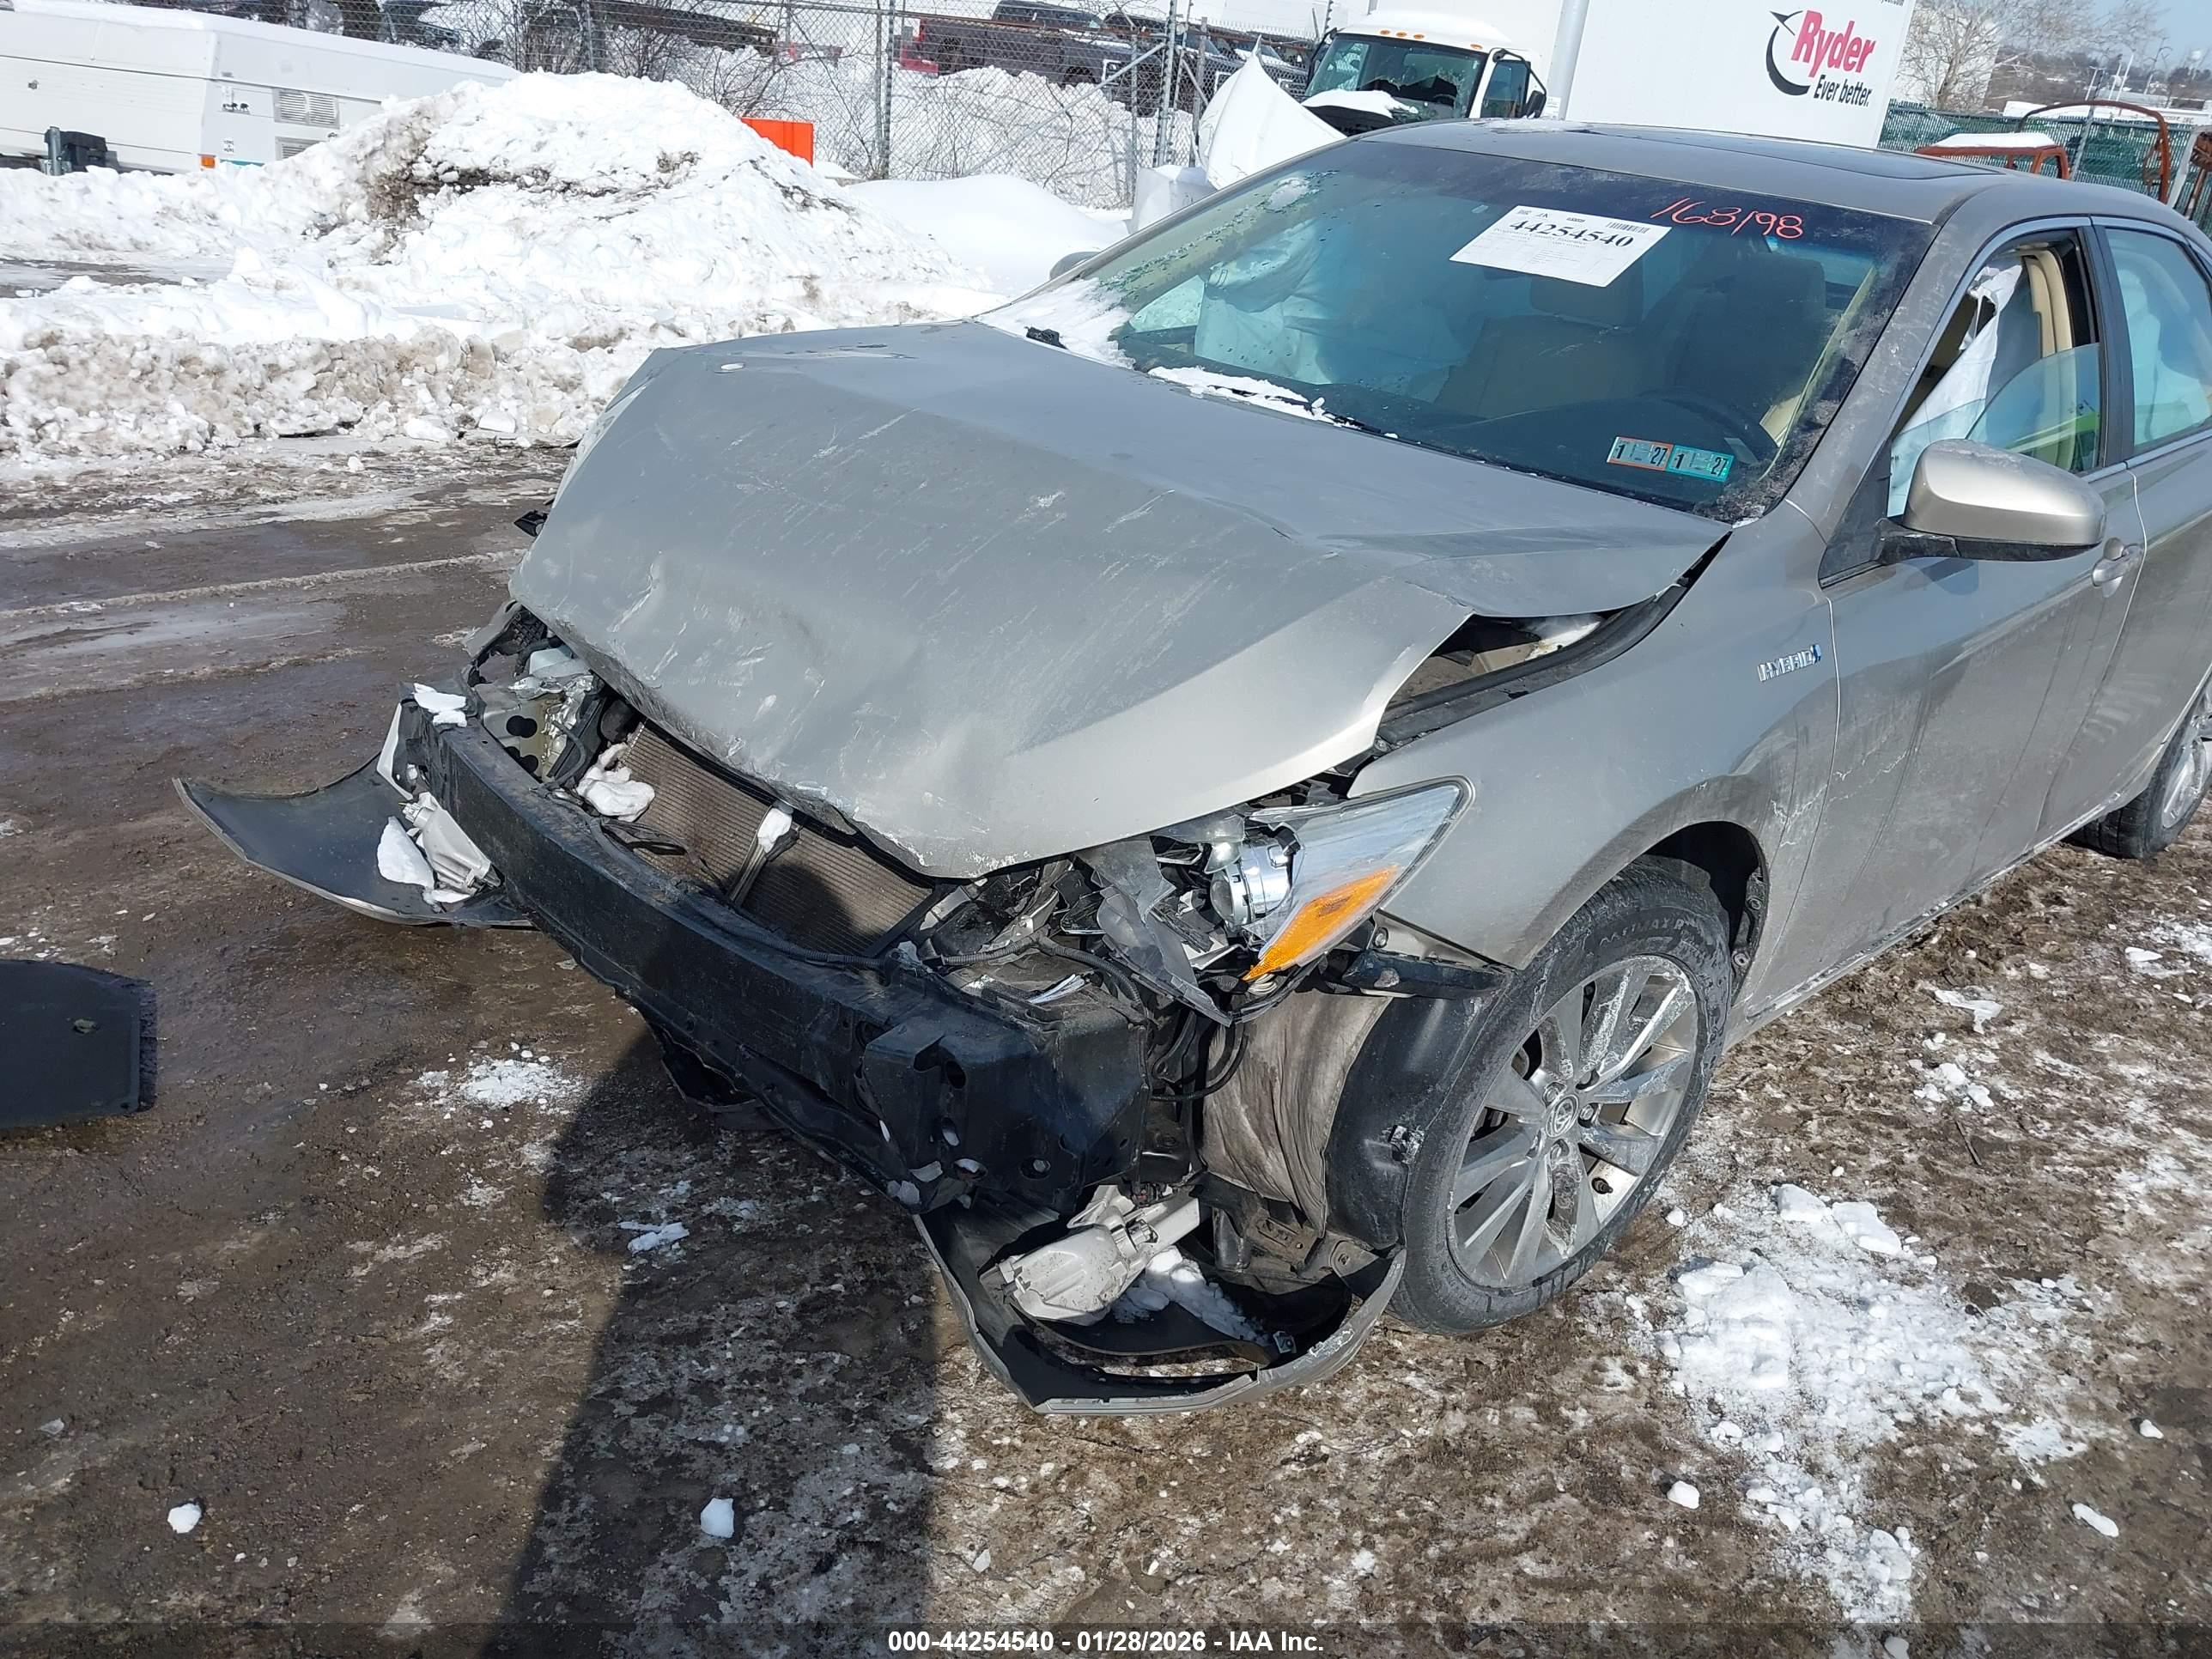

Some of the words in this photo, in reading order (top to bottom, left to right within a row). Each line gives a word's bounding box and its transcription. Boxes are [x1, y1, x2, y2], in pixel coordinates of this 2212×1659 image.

[1792, 10, 1877, 77] Ryder
[1814, 75, 1840, 102] Ever
[1838, 79, 1871, 106] better.
[1509, 220, 1634, 248] 44254540
[1616, 444, 1626, 459] 1
[1651, 447, 1668, 466] 27
[1674, 453, 1684, 469] 1
[1711, 457, 1729, 477] 27
[1758, 651, 1814, 682] HYBRID
